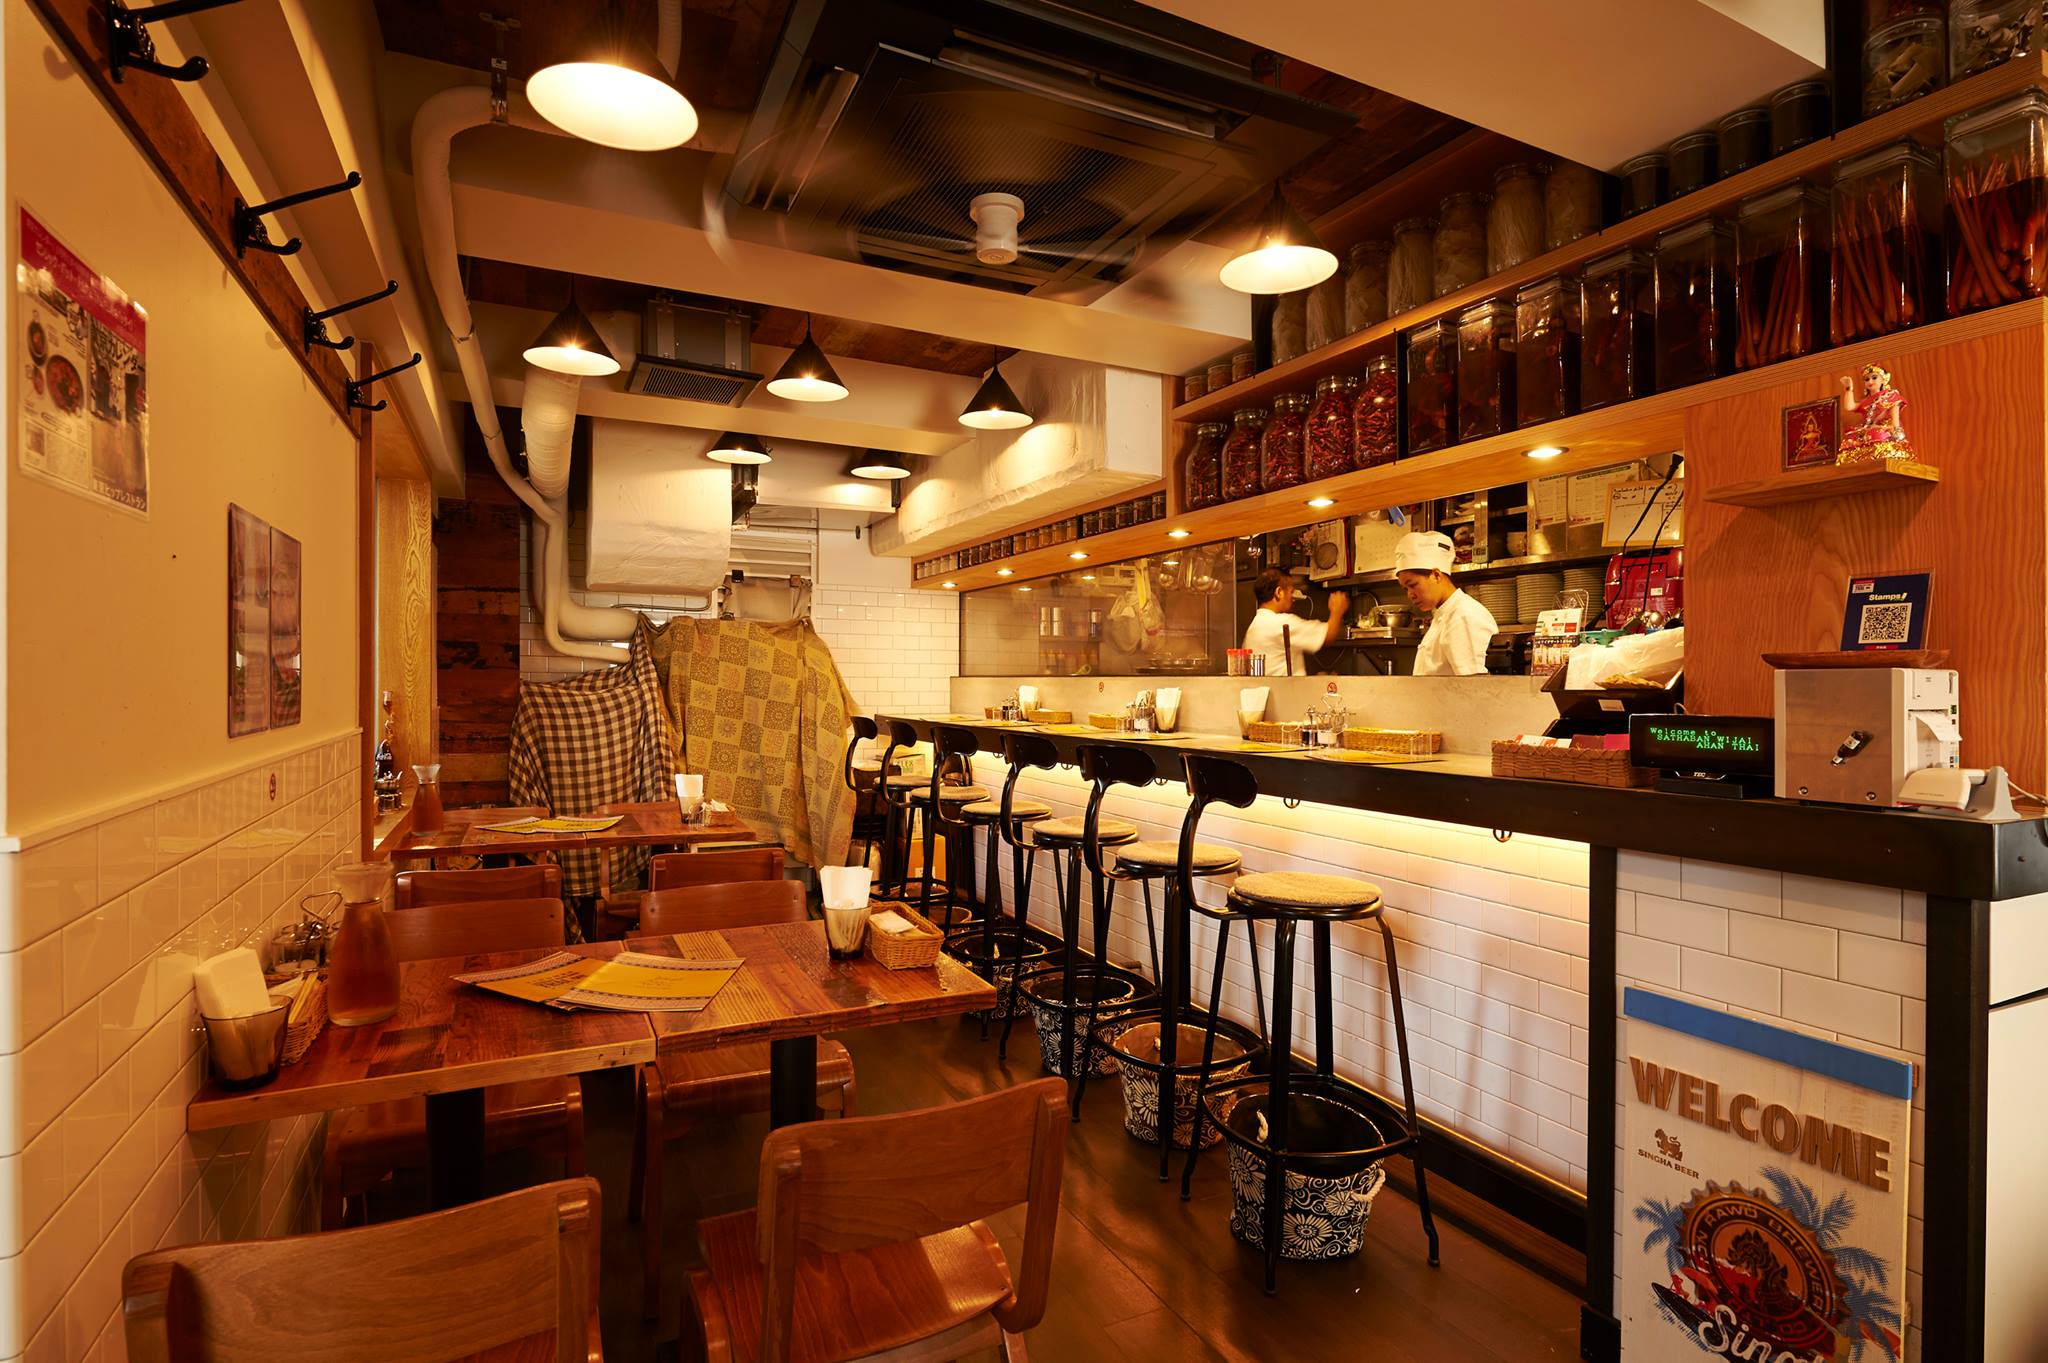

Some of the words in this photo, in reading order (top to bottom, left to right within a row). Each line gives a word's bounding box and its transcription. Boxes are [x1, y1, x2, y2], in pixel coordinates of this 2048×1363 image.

[1650, 727, 1696, 736] Welcome
[1657, 734, 1710, 742] SATHABAN
[1717, 736, 1752, 744] WIJAI
[1732, 743, 1760, 752] THAI
[1629, 1056, 1893, 1193] WELCOME
[1637, 1148, 1673, 1169] SINGHA
[1674, 1163, 1700, 1180] BEER
[1704, 1205, 1758, 1228] RAWD
[1768, 1218, 1824, 1316] BREWER
